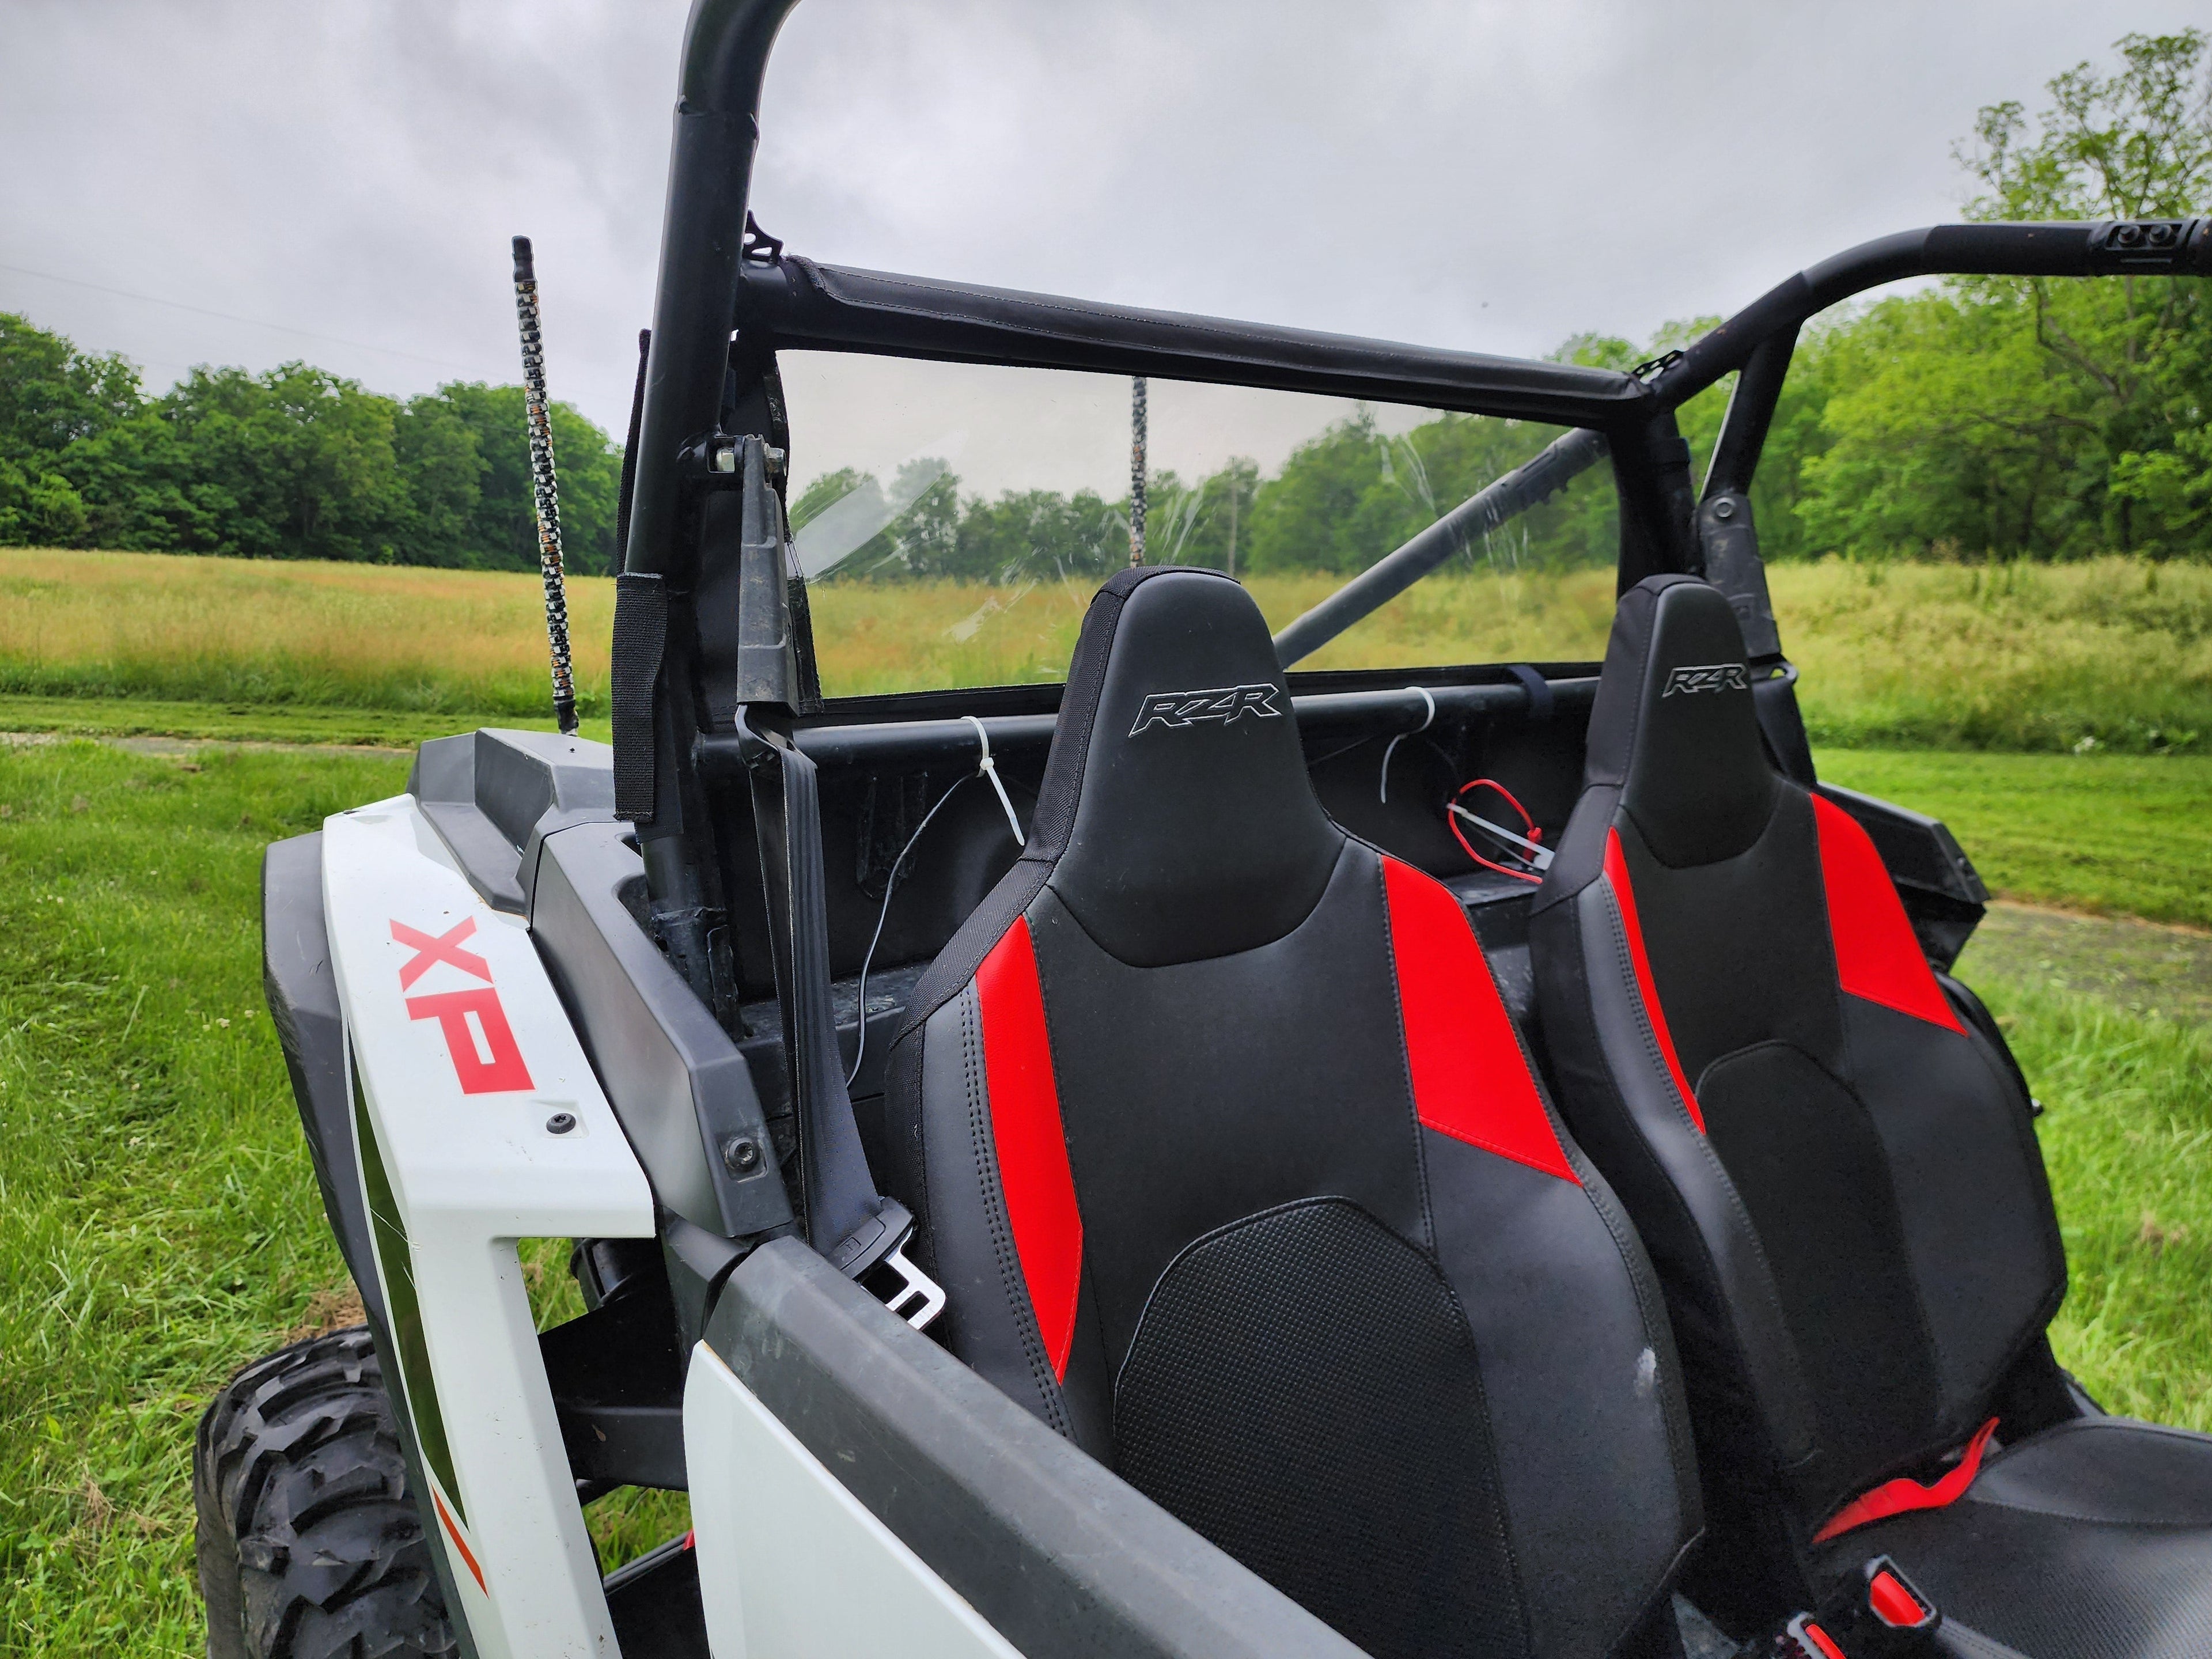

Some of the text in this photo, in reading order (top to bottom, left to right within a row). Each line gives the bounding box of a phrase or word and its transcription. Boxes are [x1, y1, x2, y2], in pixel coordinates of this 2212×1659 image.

[1662, 663, 1747, 698] RZR
[1128, 683, 1283, 737] RZR
[389, 916, 536, 1094] XP
